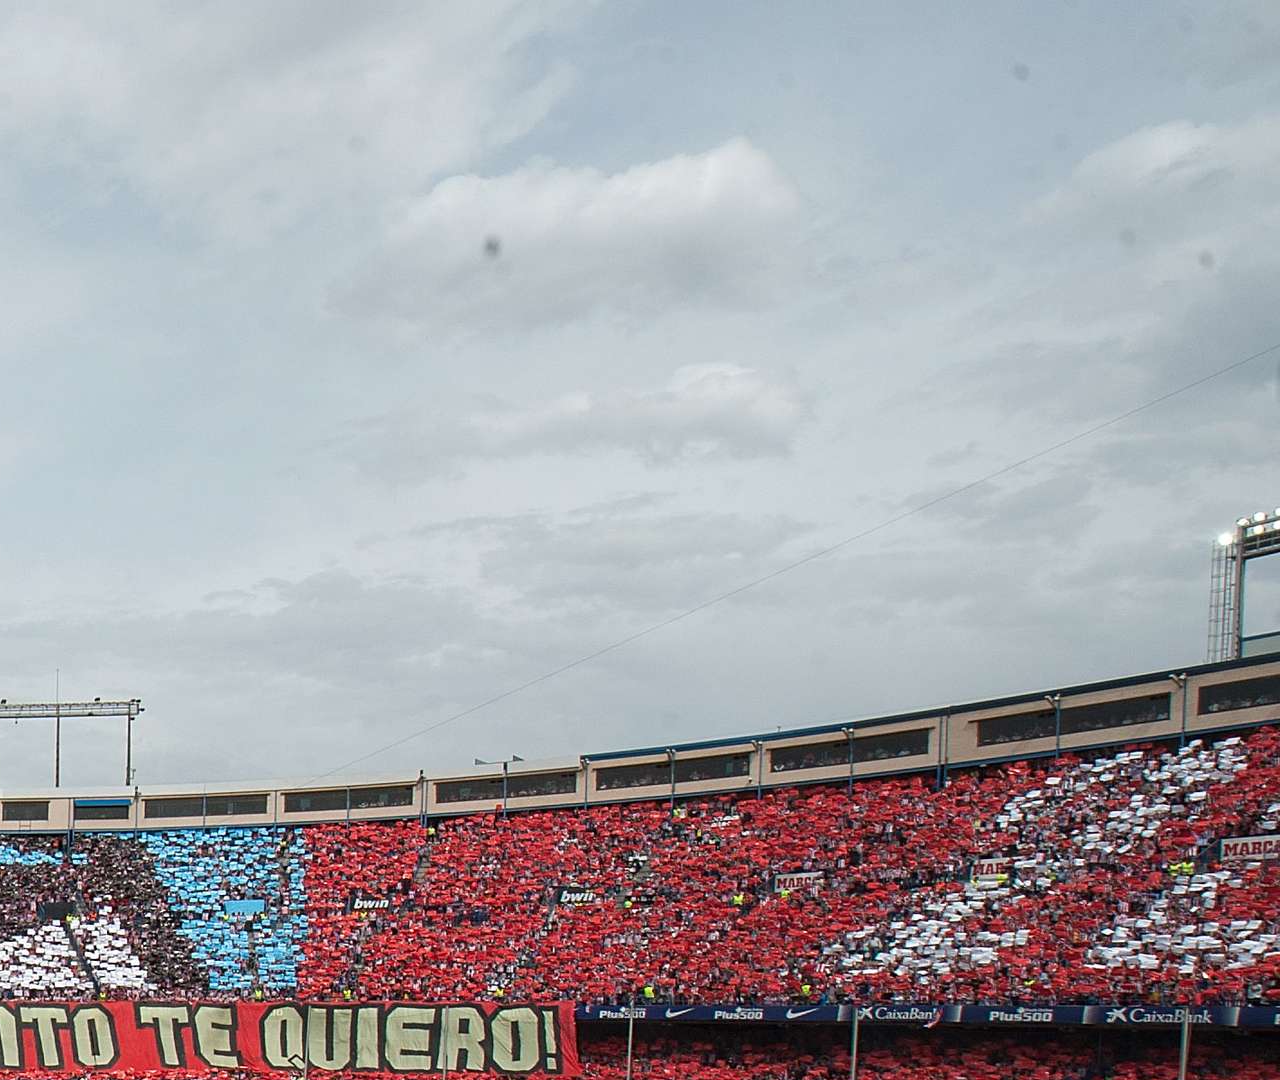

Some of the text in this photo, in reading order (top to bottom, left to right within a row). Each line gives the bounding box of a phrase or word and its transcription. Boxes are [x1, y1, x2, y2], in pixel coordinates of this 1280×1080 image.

[599, 1010, 646, 1019] Plus500
[714, 1010, 763, 1020] Plus500
[990, 1010, 1053, 1021] Plus500
[1131, 1008, 1212, 1023] CaixaBank
[140, 1007, 238, 1067] TE
[263, 1006, 558, 1071] QUIERO!
